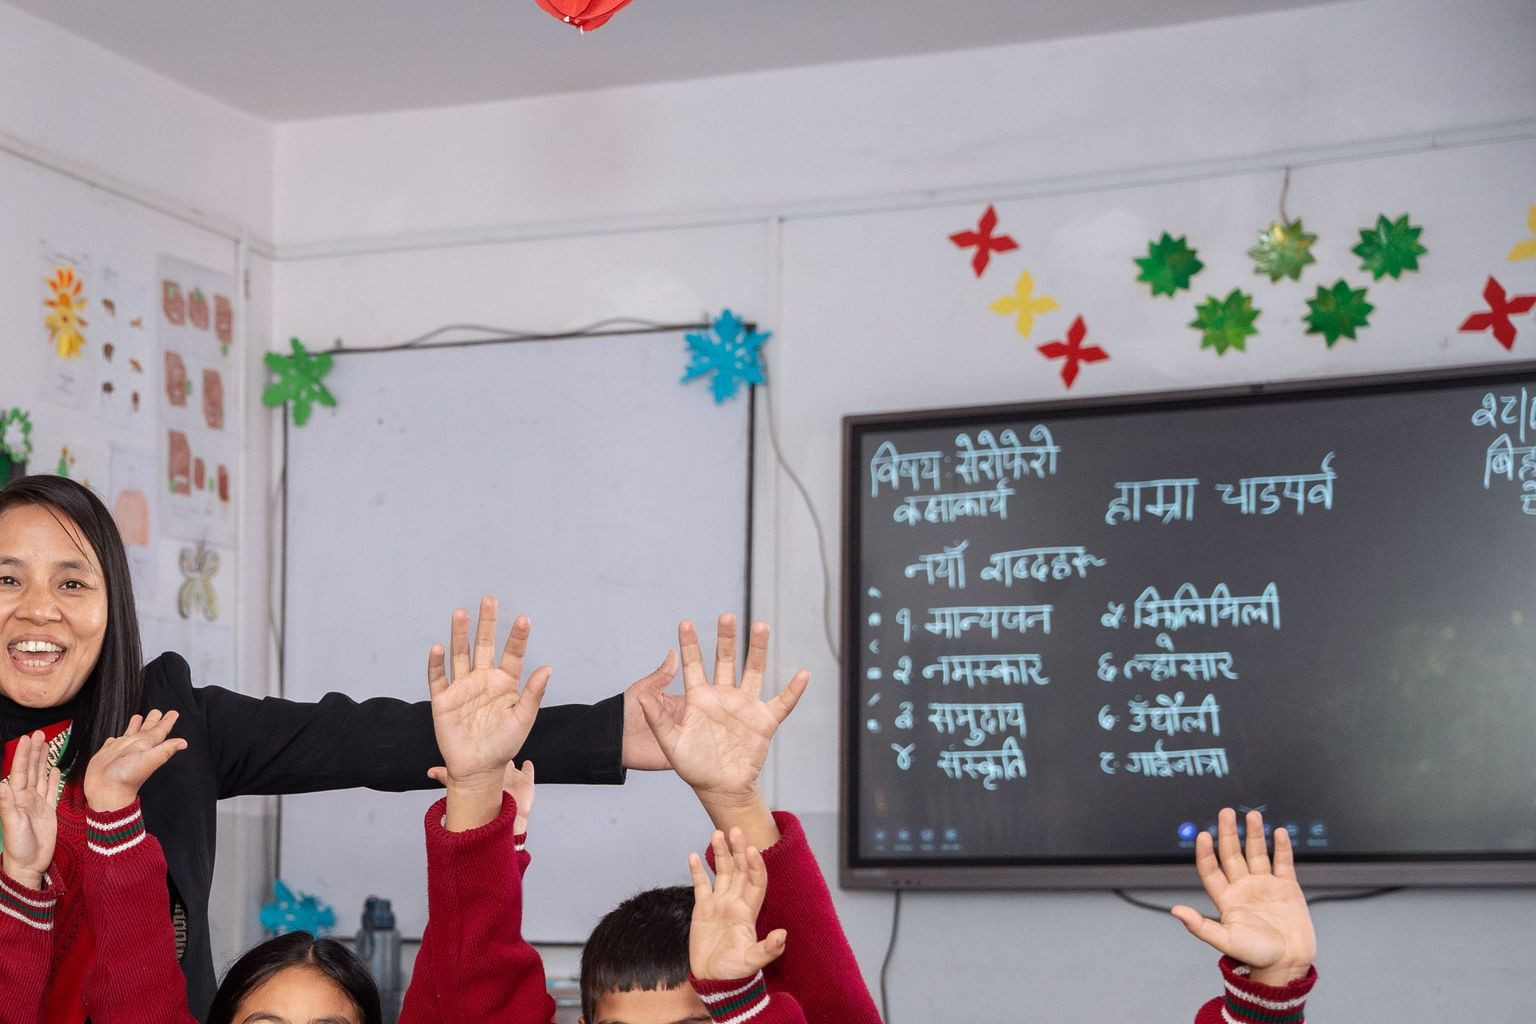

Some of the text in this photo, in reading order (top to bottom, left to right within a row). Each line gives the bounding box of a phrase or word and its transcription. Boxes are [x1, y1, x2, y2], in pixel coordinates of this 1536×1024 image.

[955, 424, 1062, 485] सेरोफेरो
[1105, 451, 1337, 525] हाम्रा चाडपर्व
[924, 604, 1054, 640] मान्यजन
[922, 653, 1052, 689] नमस्कार
[927, 702, 1027, 747] समुदाय
